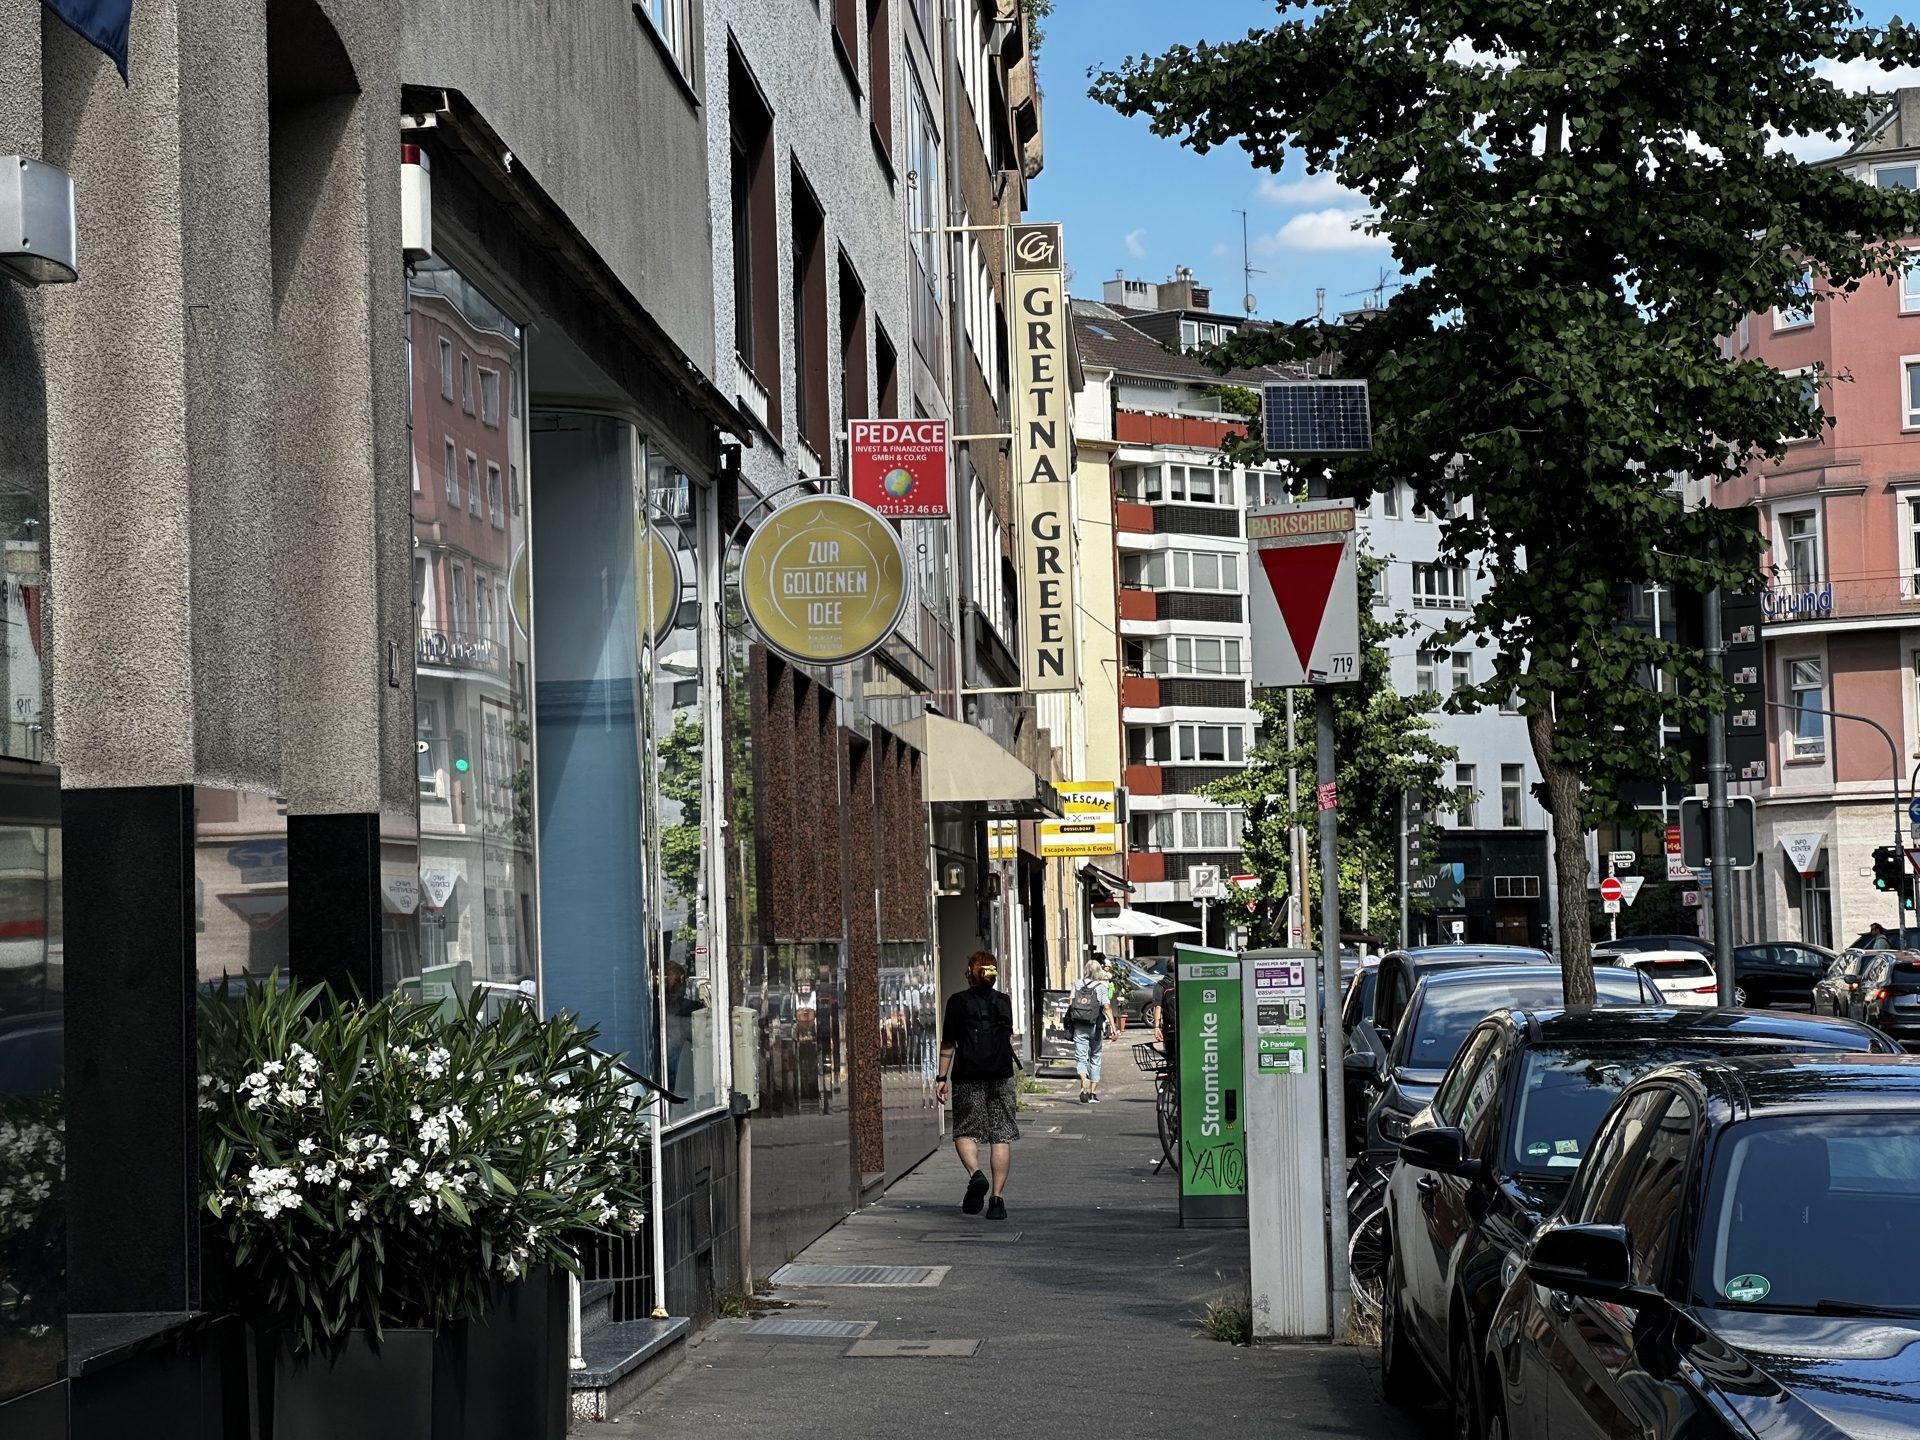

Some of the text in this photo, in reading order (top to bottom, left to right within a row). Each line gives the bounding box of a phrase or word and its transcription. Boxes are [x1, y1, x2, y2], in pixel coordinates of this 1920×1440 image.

[855, 424, 944, 443] PEDACE
[1023, 287, 1065, 677] GRETNA GREEN
[877, 505, 944, 514] 0211-32 46 63
[1252, 511, 1348, 536] PARKSCHEINE
[807, 541, 839, 564] ZUR
[783, 571, 867, 594] GOLDENEN
[1761, 583, 1833, 616] Grund
[807, 602, 843, 625] IDEE
[1333, 656, 1353, 673] 719
[1064, 793, 1111, 811] MESCAPE
[1199, 1012, 1220, 1137] Stromtanke
[1741, 1276, 1754, 1288] 4
